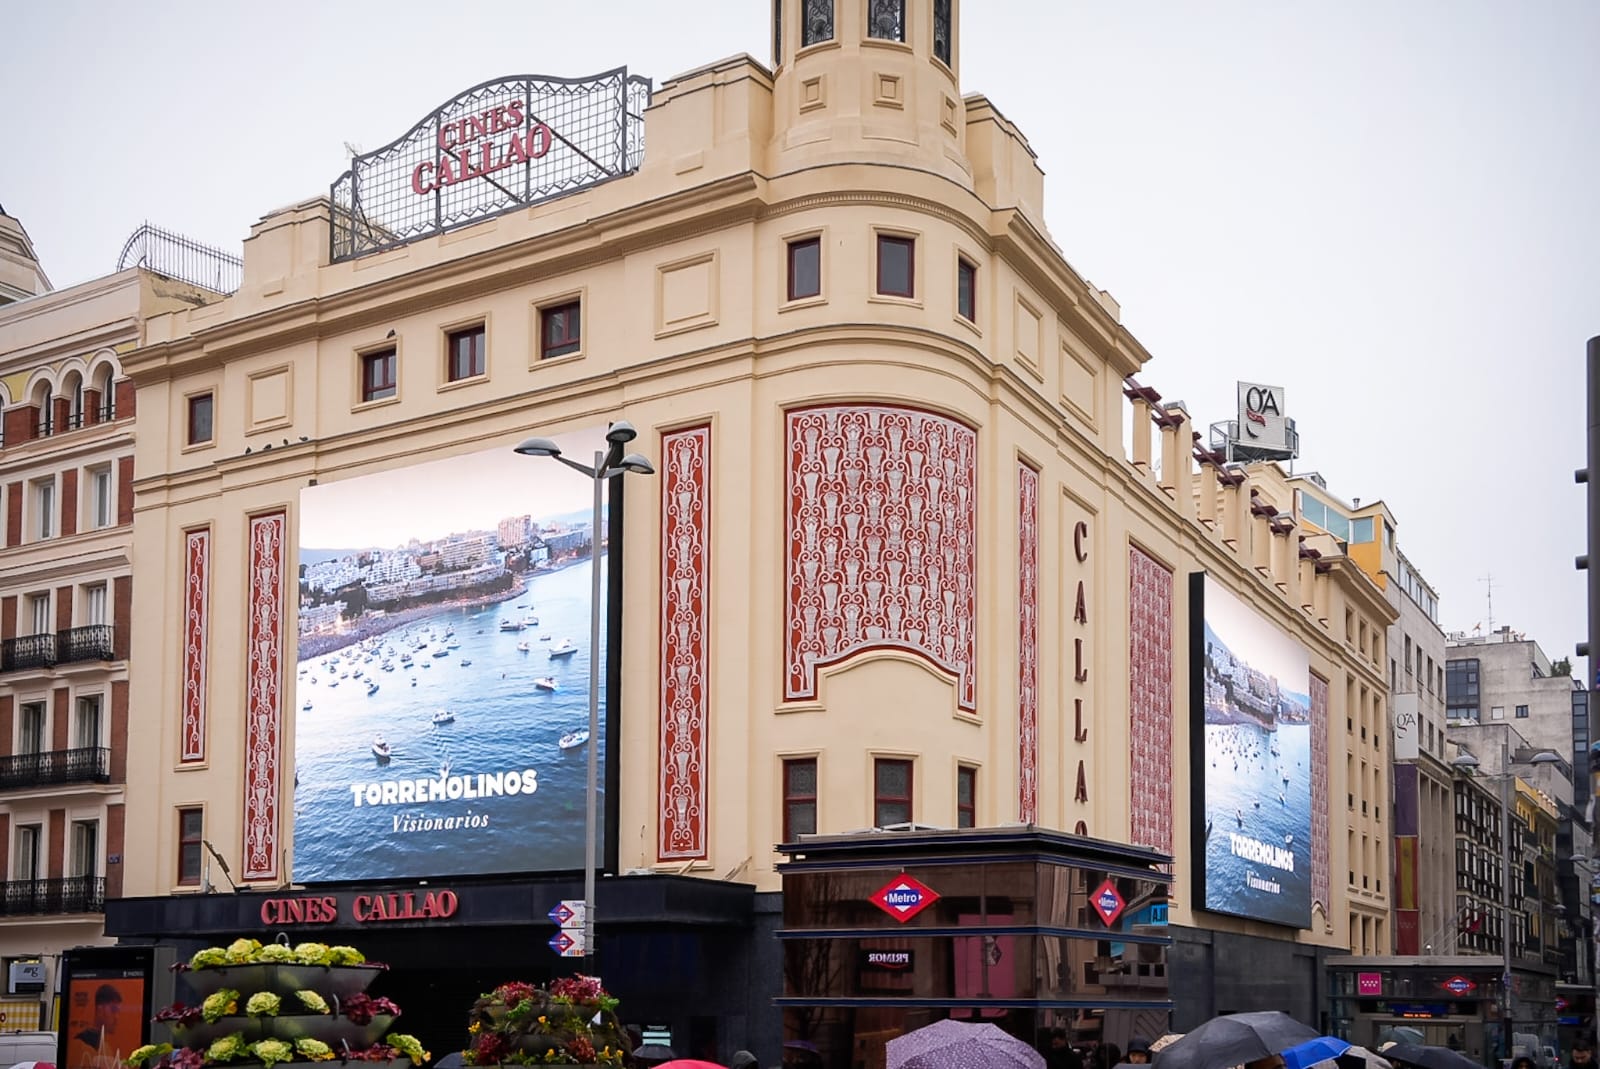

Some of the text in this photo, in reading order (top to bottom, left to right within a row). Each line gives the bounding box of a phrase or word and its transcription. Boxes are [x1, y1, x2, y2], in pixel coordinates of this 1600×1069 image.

[438, 99, 525, 152] CINES
[412, 123, 553, 195] CALLAO
[350, 768, 538, 808] TORREMOLINOS
[392, 809, 489, 833] Visionarios
[1229, 832, 1295, 873] TORREMOLINOS
[261, 889, 458, 925] CINES CALLAO
[888, 893, 917, 904] Metro
